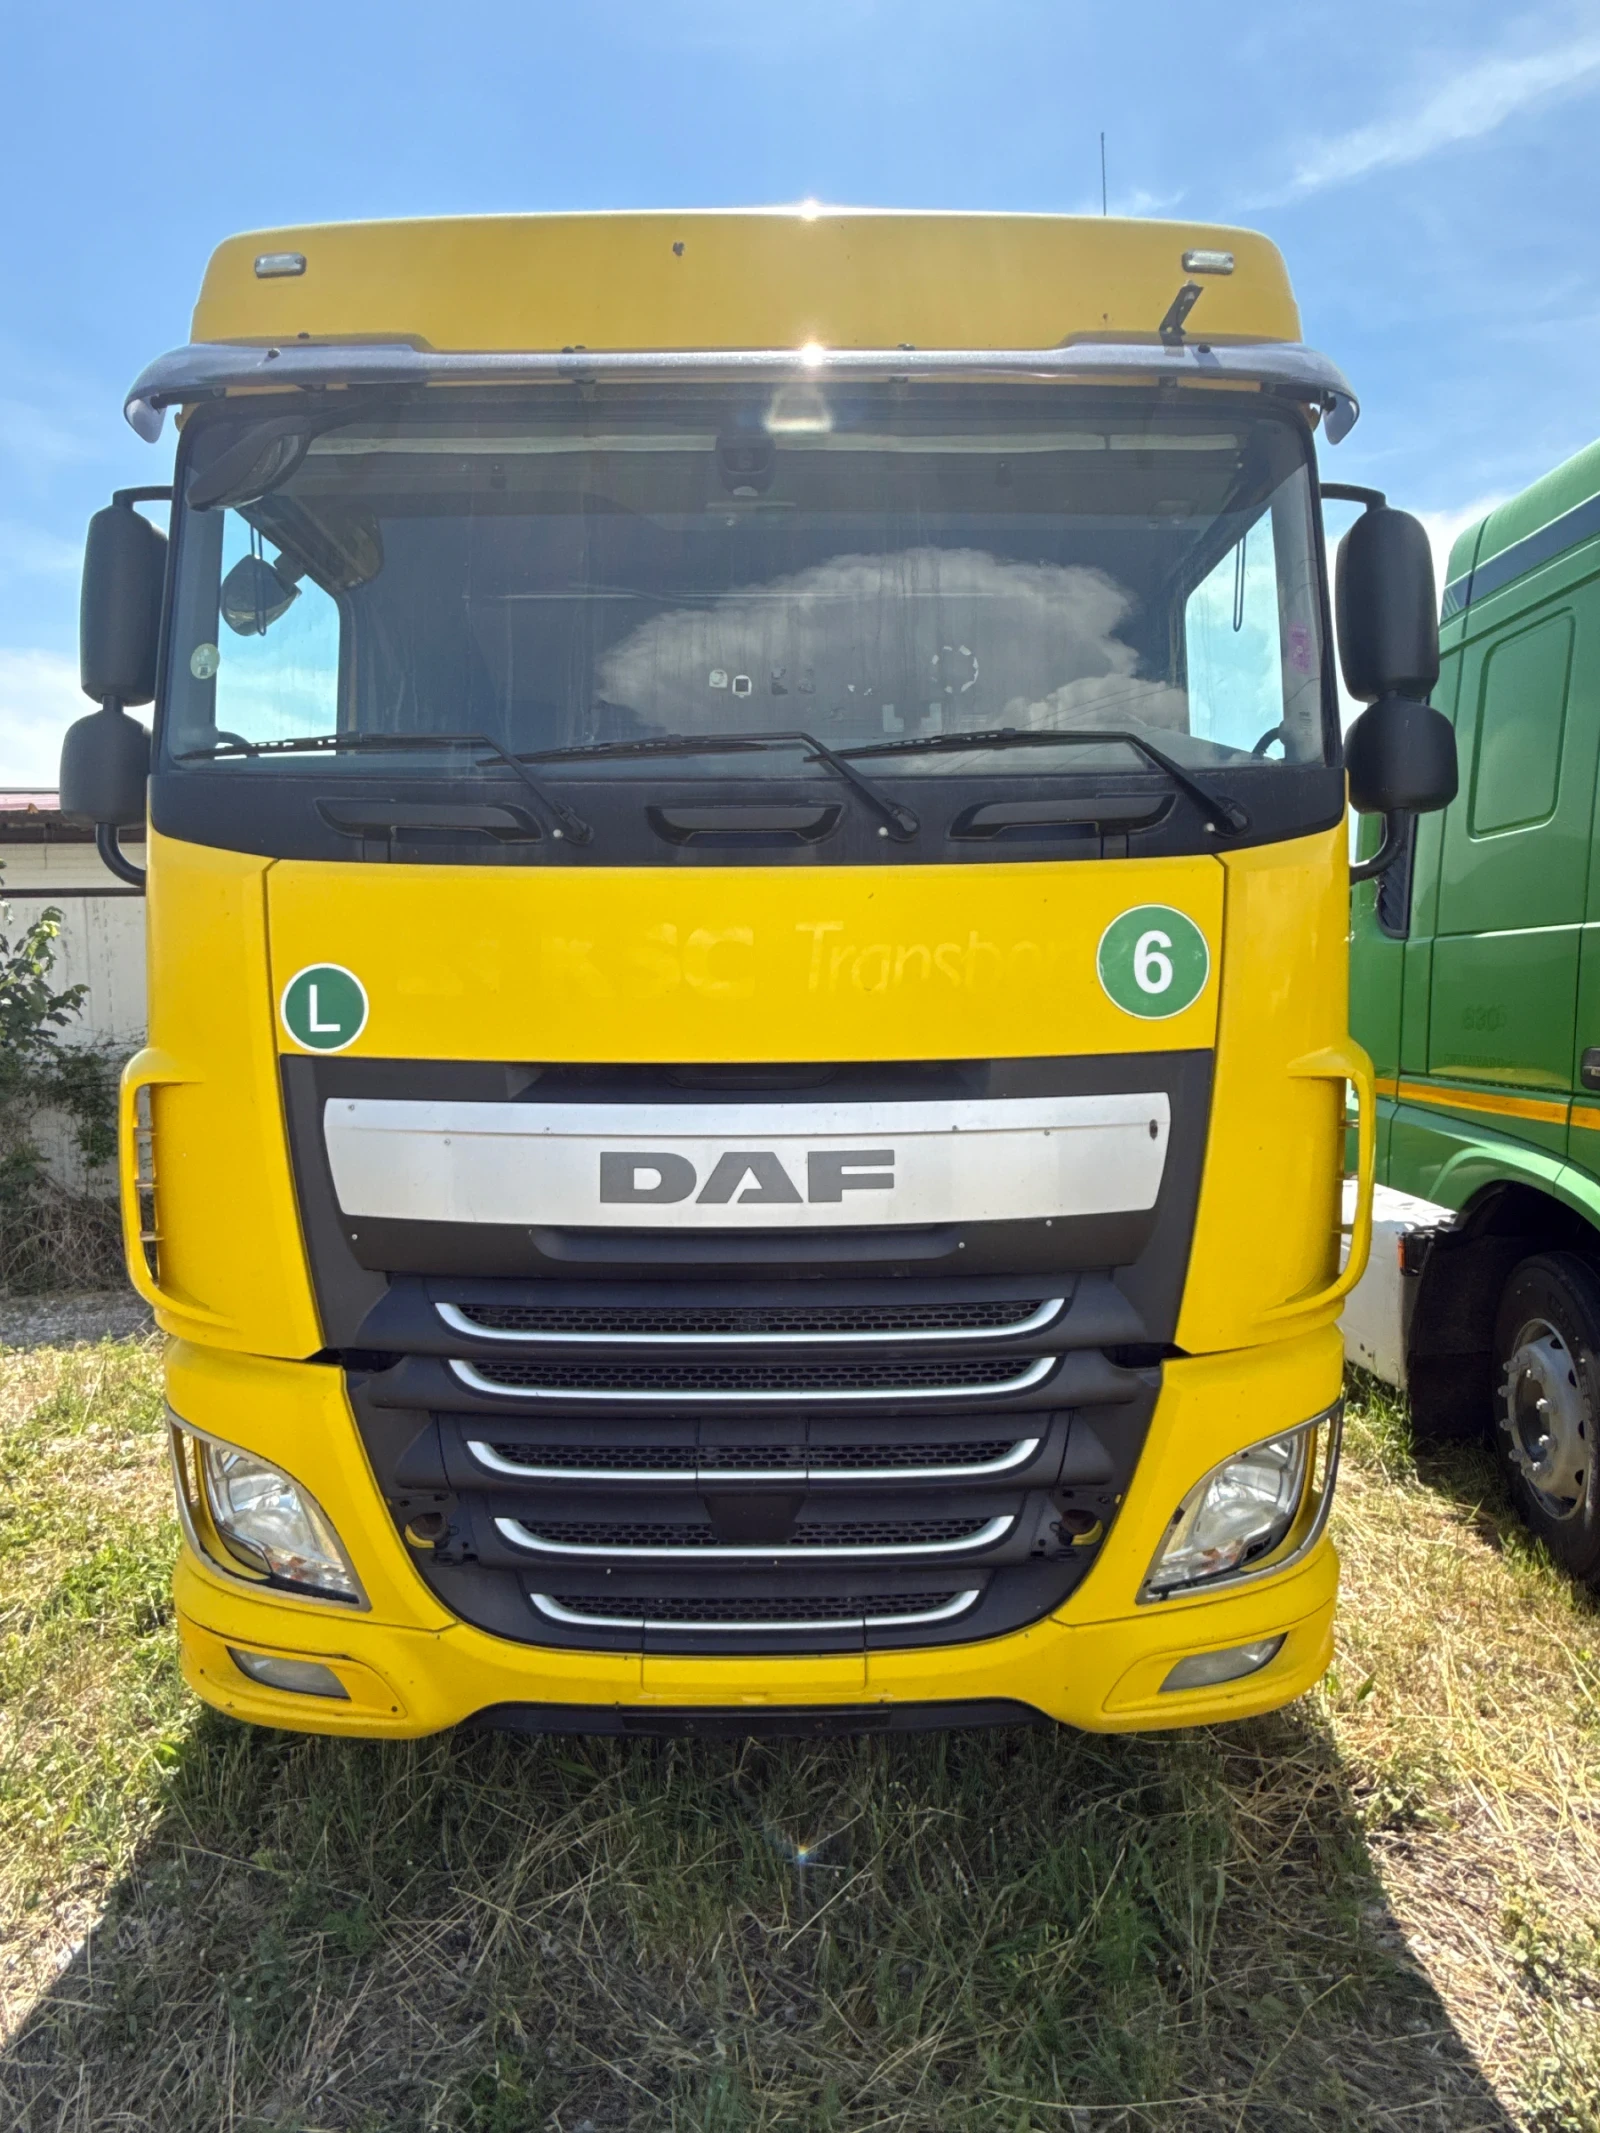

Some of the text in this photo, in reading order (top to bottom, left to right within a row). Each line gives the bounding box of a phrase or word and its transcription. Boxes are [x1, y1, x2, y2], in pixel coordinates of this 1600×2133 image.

[1133, 929, 1174, 995] 6
[309, 983, 342, 1033] L
[599, 1148, 896, 1204] DAF
